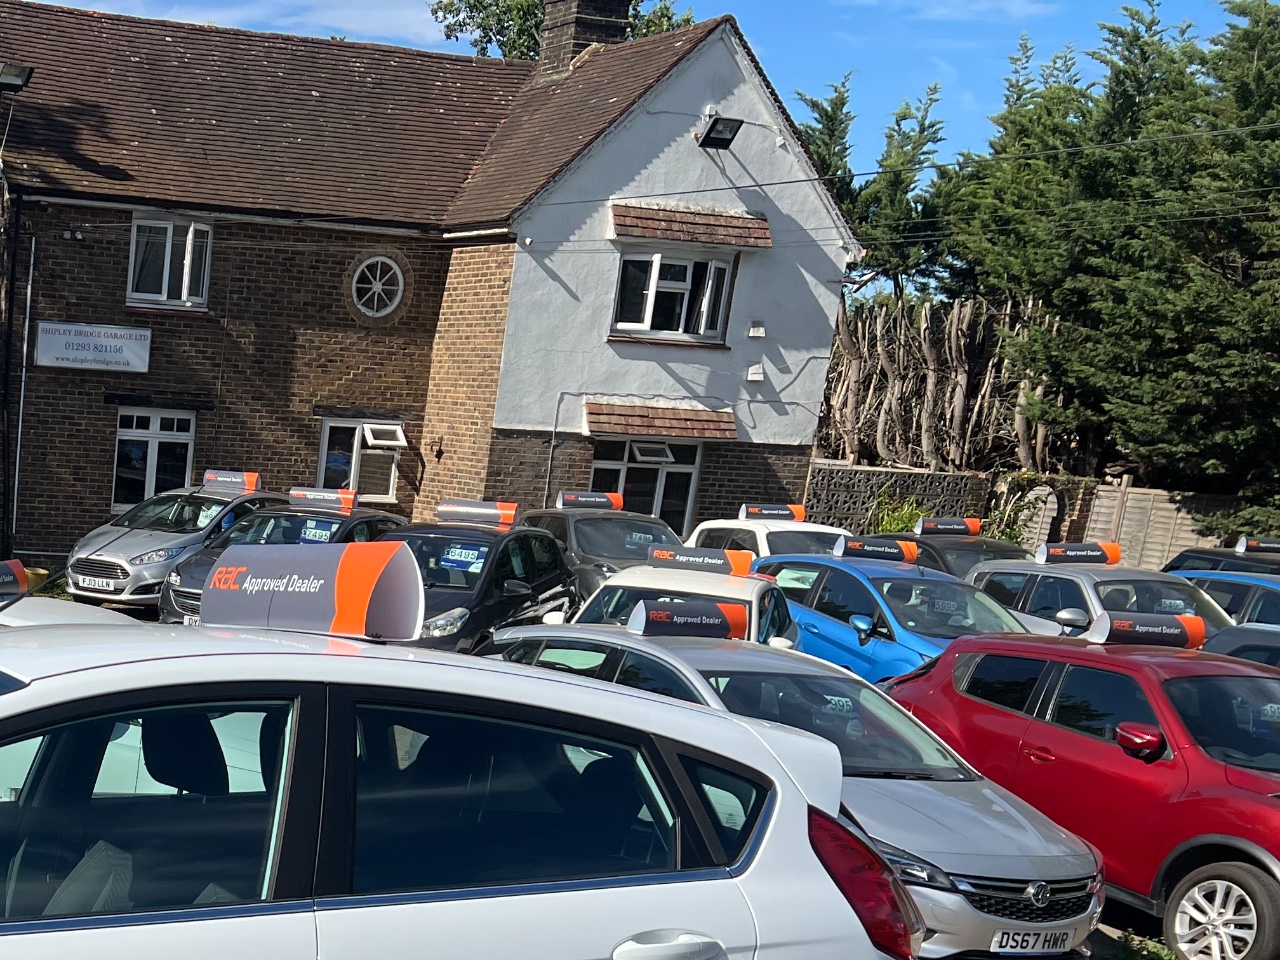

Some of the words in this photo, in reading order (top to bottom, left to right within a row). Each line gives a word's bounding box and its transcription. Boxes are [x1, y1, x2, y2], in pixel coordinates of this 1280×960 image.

[40, 327, 72, 336] SHIPLEY
[74, 329, 101, 338] BRIDGE
[103, 331, 133, 340] GARAGE
[134, 333, 149, 341] LTD
[65, 341, 91, 351] 01293
[93, 343, 123, 353] 821156
[55, 355, 131, 366] www.shipleybridge.co.uk
[864, 544, 885, 552] Approved
[675, 554, 703, 563] Approved
[704, 556, 725, 565] Dealer
[82, 580, 96, 588] FJ13
[97, 581, 111, 589] LLN
[242, 574, 288, 594] Approved
[288, 574, 324, 593] Dealer
[673, 615, 701, 624] Approved
[702, 615, 722, 624] Dealer
[1135, 624, 1162, 634] Approved
[1162, 625, 1182, 635] Dealer
[998, 931, 1041, 949] DS67
[1042, 932, 1069, 949] HWR
